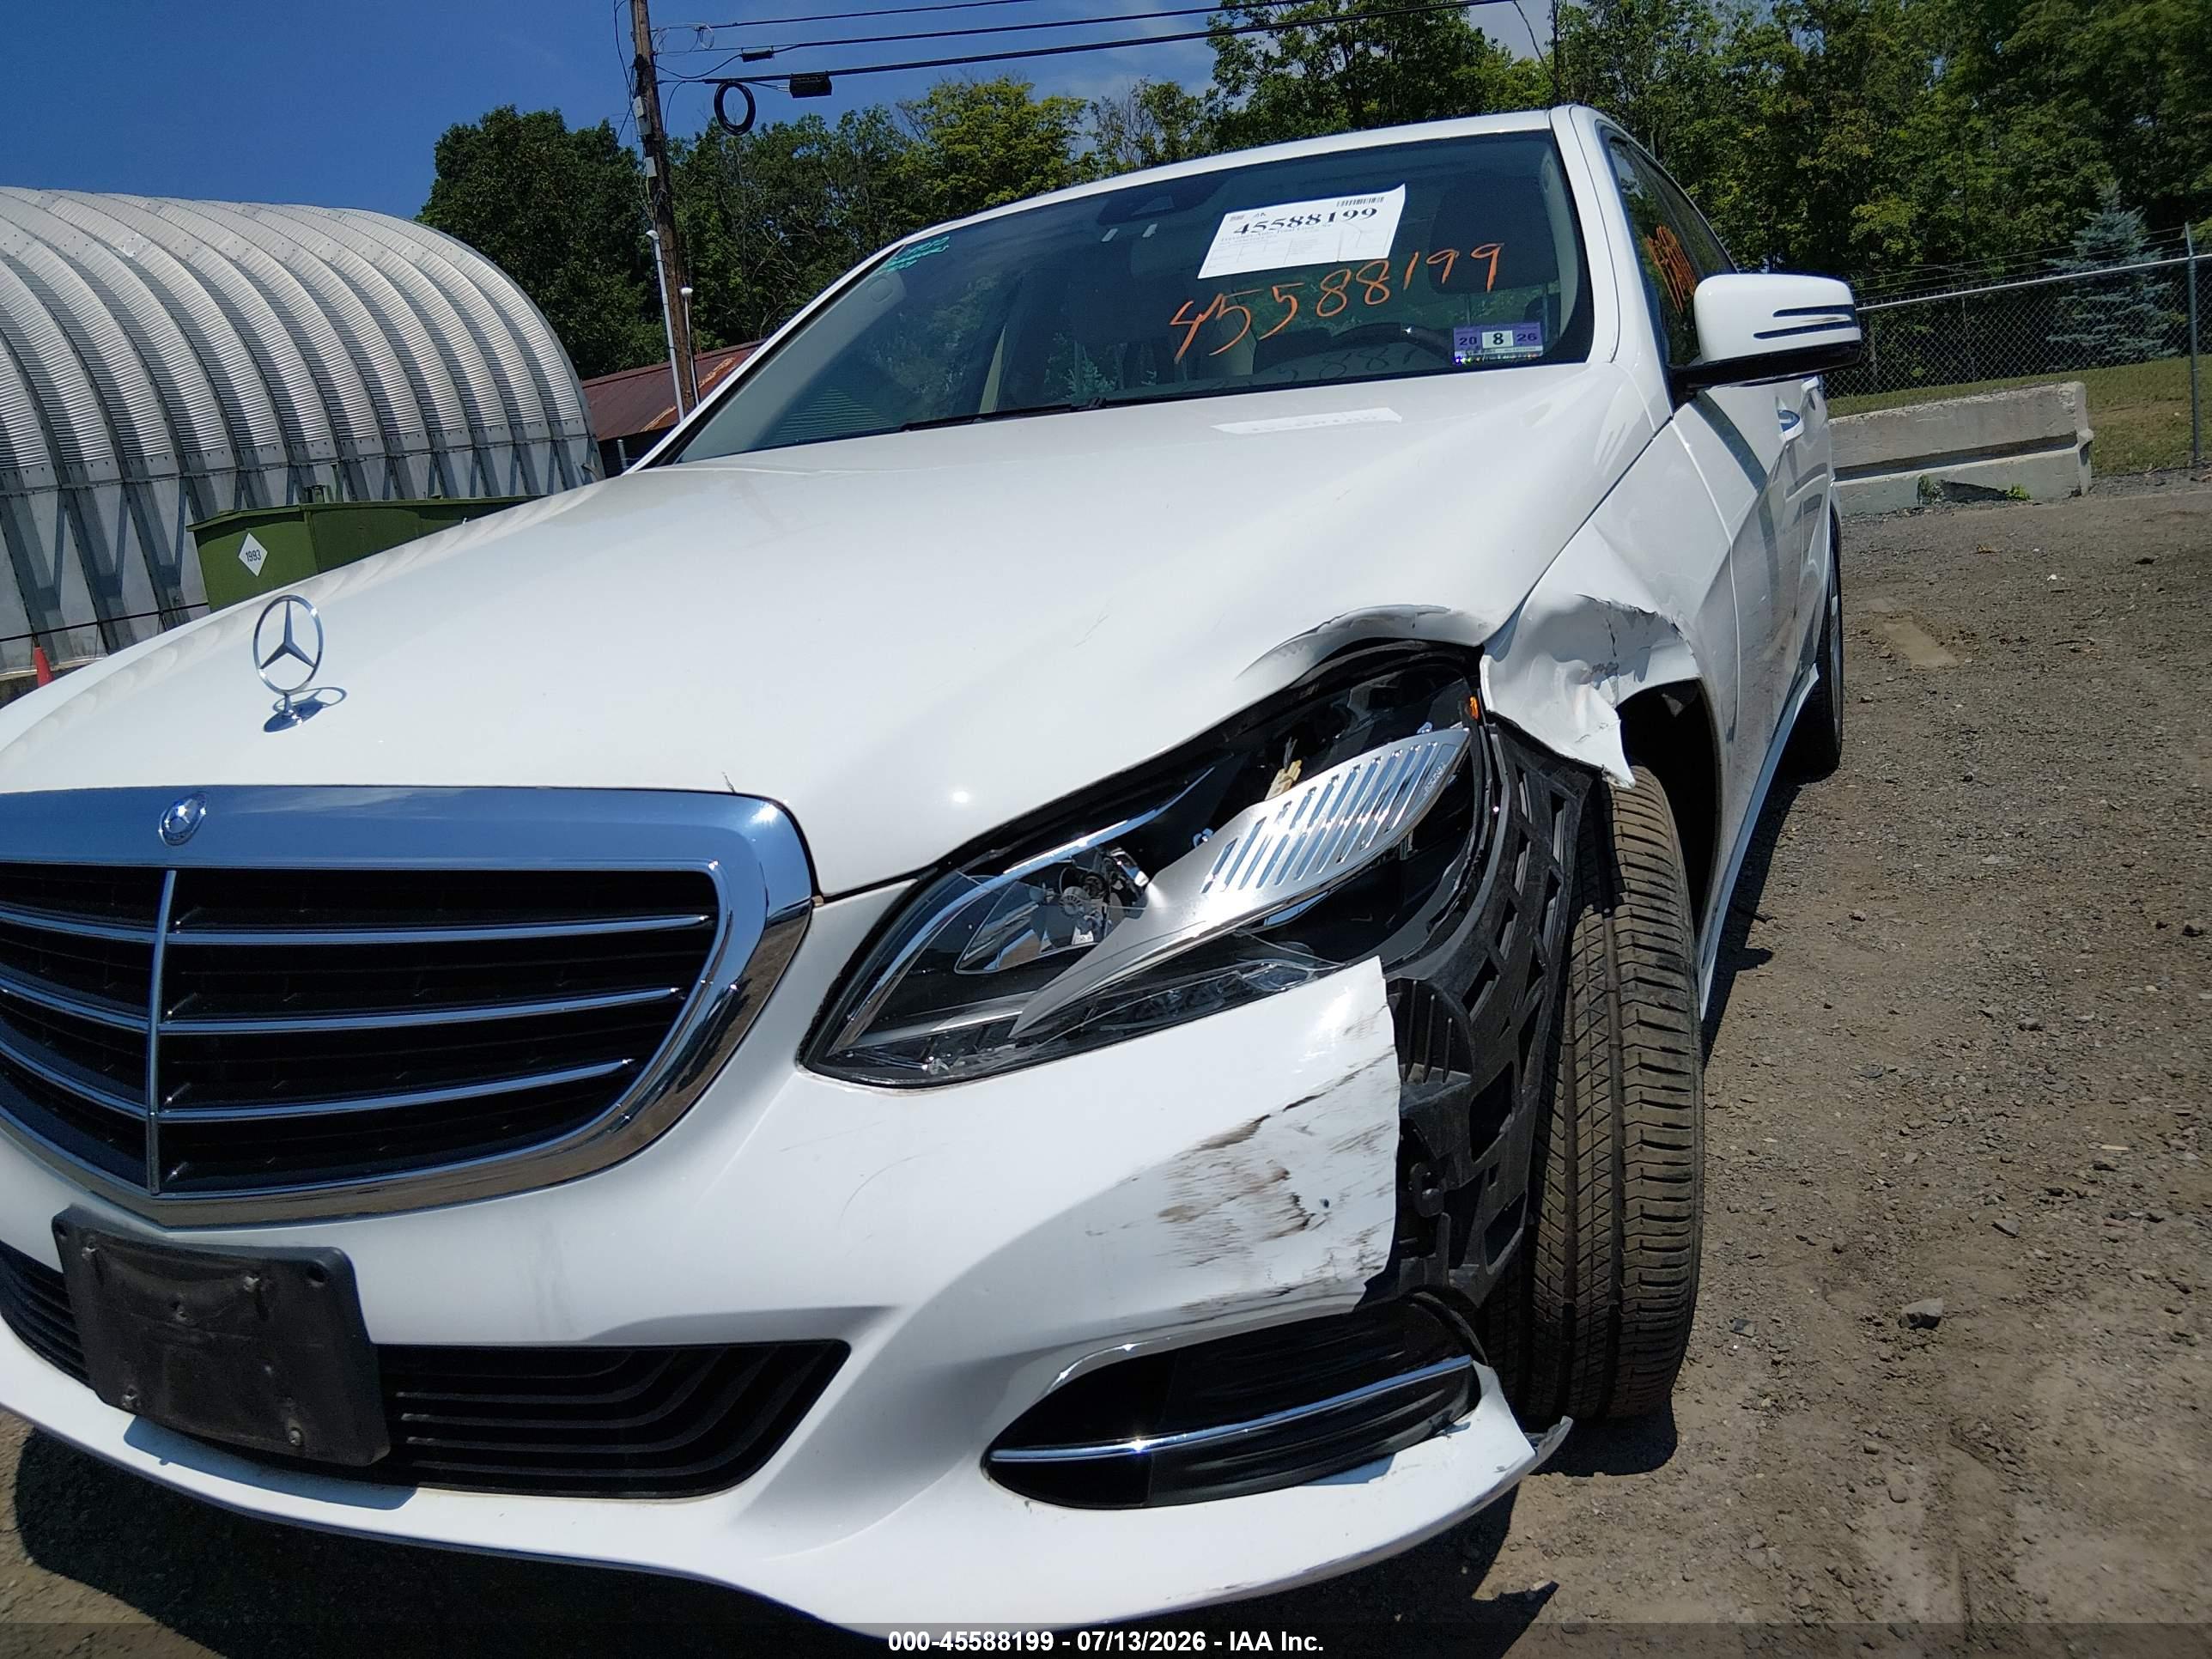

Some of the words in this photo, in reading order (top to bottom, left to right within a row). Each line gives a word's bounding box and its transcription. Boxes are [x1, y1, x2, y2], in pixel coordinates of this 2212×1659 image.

[1233, 207, 1378, 235] 45588199
[1169, 242, 1504, 365] 45588199
[1460, 337, 1477, 345] 20
[1492, 332, 1504, 345] 8
[1516, 332, 1537, 342] 26
[246, 549, 261, 562] 1993
